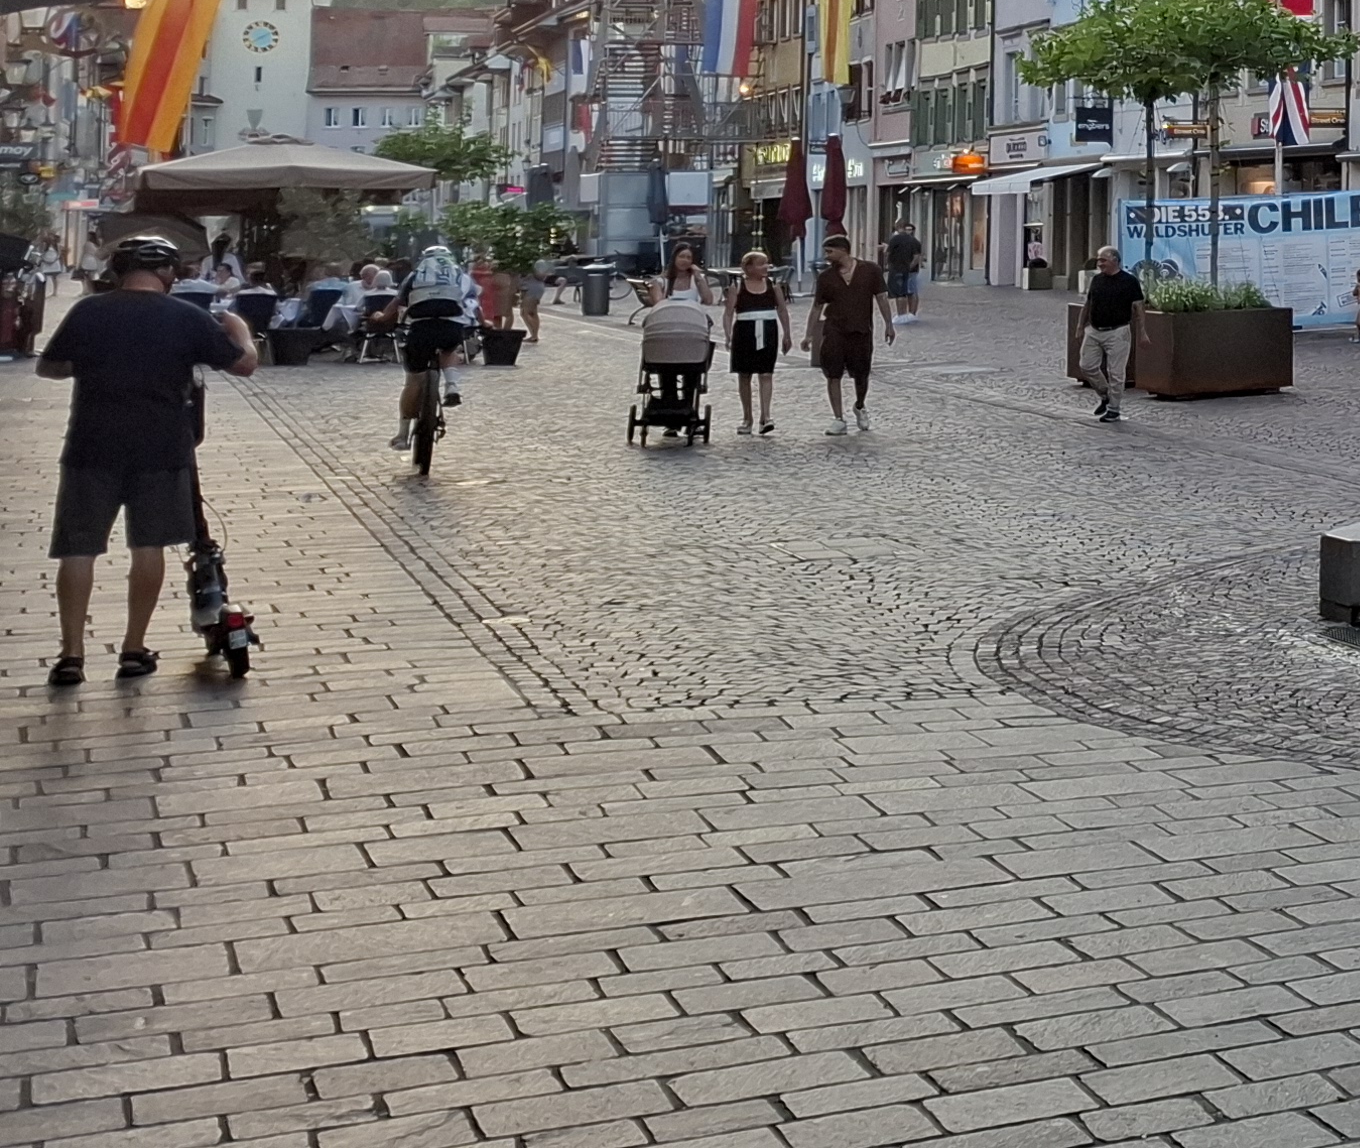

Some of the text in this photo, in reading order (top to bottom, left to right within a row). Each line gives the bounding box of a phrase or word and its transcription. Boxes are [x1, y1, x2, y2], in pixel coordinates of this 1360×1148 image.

[1077, 122, 1111, 131] engbers
[1153, 205, 1181, 223] DIE
[1127, 222, 1245, 239] WLDSHUER
